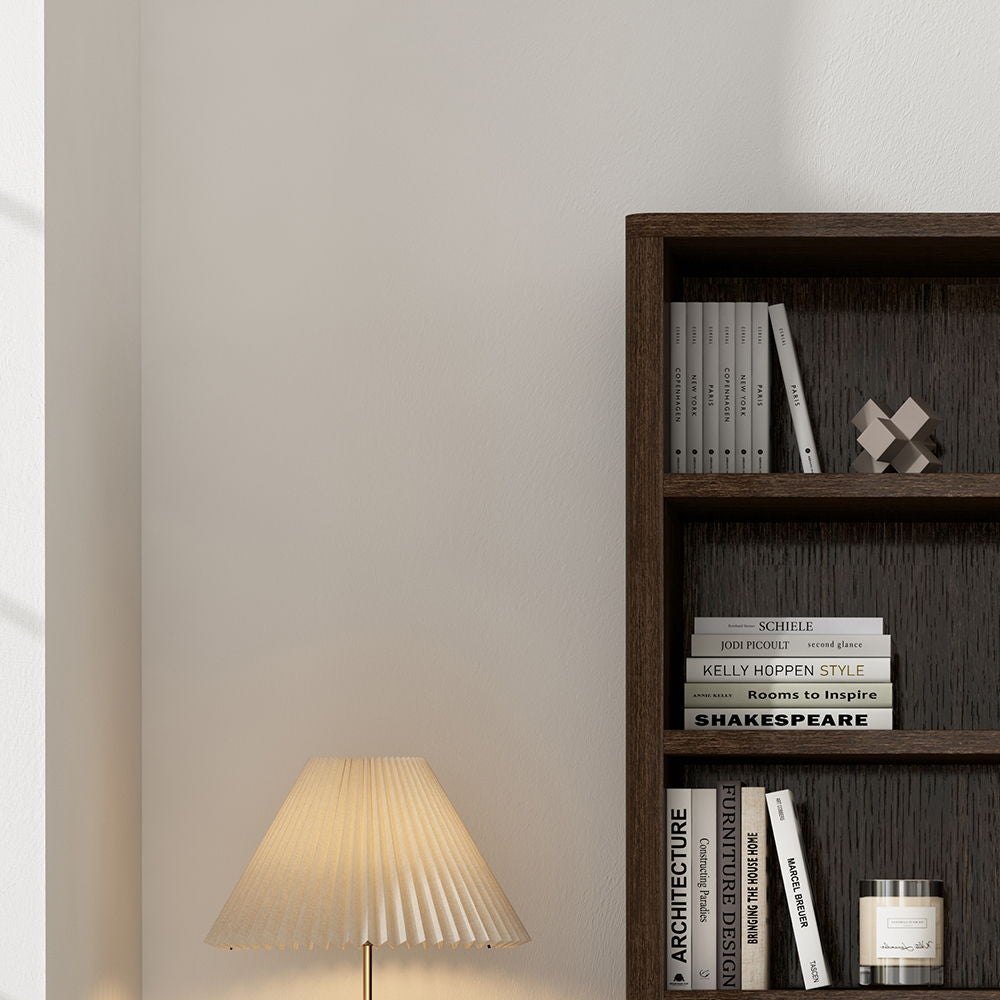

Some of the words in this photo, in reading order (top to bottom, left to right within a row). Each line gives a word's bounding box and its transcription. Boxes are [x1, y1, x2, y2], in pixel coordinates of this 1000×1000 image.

[791, 384, 801, 407] PARIS
[758, 621, 814, 632] SCHIELE
[721, 641, 743, 651] JODI
[746, 641, 789, 650] PICOULT
[837, 641, 863, 650] glance
[703, 665, 749, 676] KELLY
[754, 665, 814, 676] HOPPEN
[820, 665, 865, 676] STYLE
[748, 690, 799, 700] Rooms
[804, 690, 820, 700] to
[825, 689, 878, 702] Inspire
[694, 714, 868, 727] SHAKESPEARE
[722, 785, 736, 905] FURNITURE
[747, 832, 758, 856] HOME
[697, 838, 710, 888] Constructing
[747, 858, 758, 884] HOUSE
[671, 808, 687, 963] ARCHITECTURE
[747, 886, 758, 903] THE
[787, 857, 801, 893] MARCEL
[794, 893, 809, 929] BREUER
[699, 890, 710, 923] Paradies
[747, 905, 758, 945] BRINGING
[722, 912, 736, 987] DESIGN
